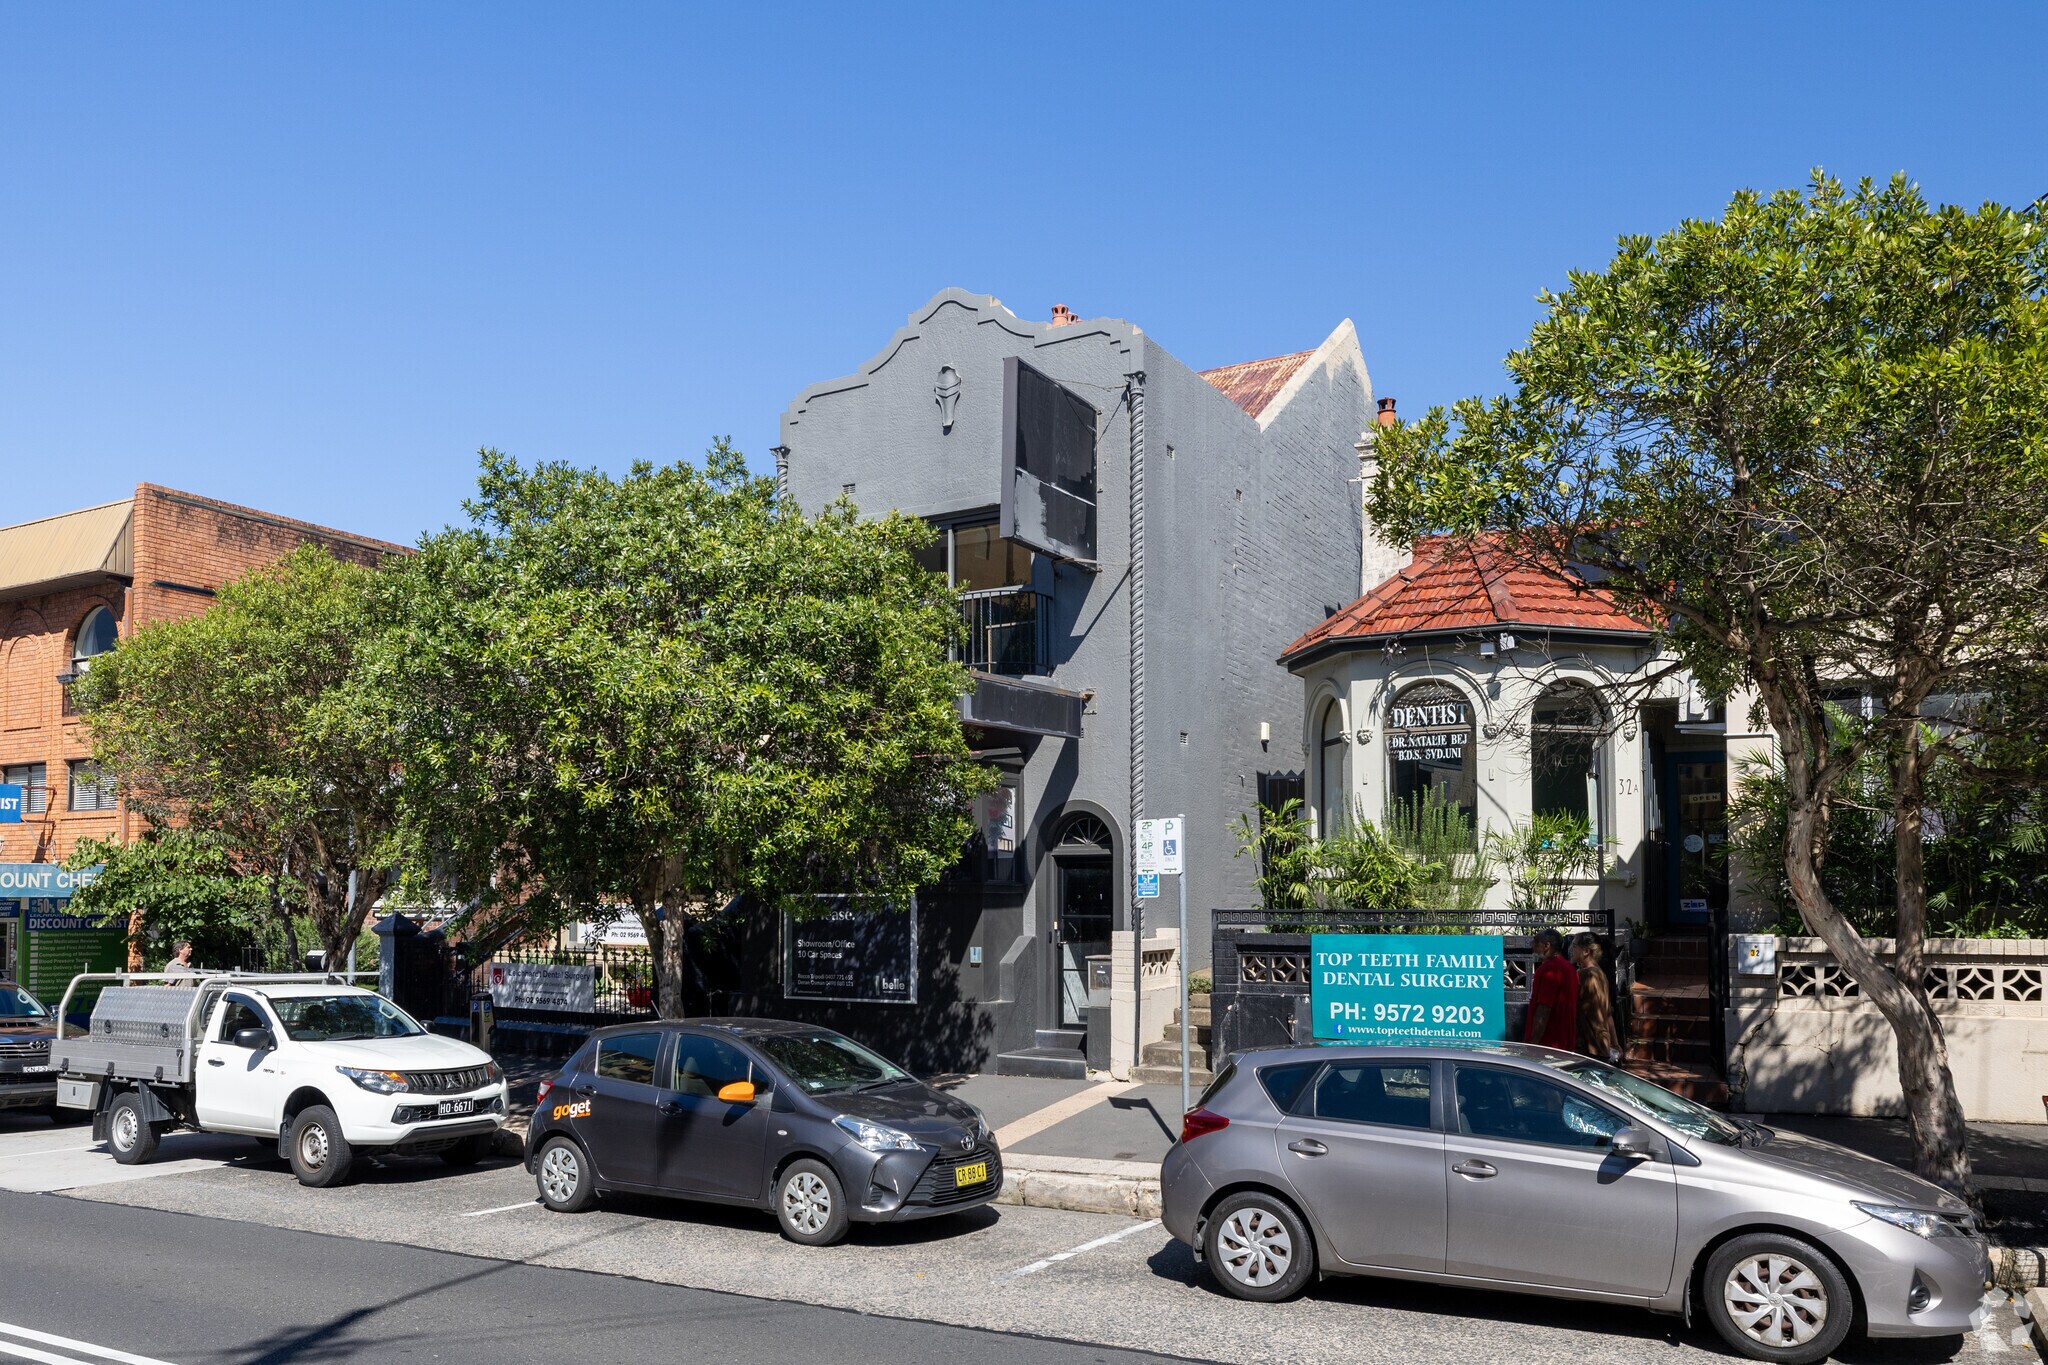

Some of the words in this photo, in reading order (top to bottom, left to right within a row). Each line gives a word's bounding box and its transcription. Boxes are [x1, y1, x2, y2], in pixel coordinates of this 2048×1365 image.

[1392, 703, 1468, 727] DENTIST
[1392, 736, 1407, 747] DR.
[1407, 734, 1447, 747] NATALIE
[1451, 734, 1468, 745] BEJ
[1399, 751, 1422, 761] B.D.S.
[1619, 779, 1639, 795] 32A
[0, 798, 19, 810] IST
[1142, 821, 1153, 830] 2P
[1142, 842, 1153, 850] 4P
[37, 898, 55, 914] 50%
[29, 918, 83, 929] DISCOUNT
[797, 940, 856, 949] Showroom/Office
[797, 950, 807, 958] 10
[807, 950, 819, 958] Car
[820, 951, 842, 960] Spaces
[1316, 953, 1353, 967] TOP
[1357, 954, 1419, 968] TEETH
[1426, 954, 1499, 969] FAMILY
[543, 970, 564, 979] Dental
[565, 971, 591, 982] Surgery
[1323, 972, 1395, 987] DENTAL
[1401, 973, 1493, 989] SURGERY
[882, 977, 905, 990] belle
[536, 997, 550, 1005] 9569
[552, 998, 568, 1006] 4874
[1330, 1002, 1367, 1021] PH:
[1374, 1003, 1425, 1022] 9572
[1432, 1005, 1485, 1025] 9203
[1348, 1026, 1482, 1038] www.topteethdental.com
[553, 1099, 591, 1121] goget
